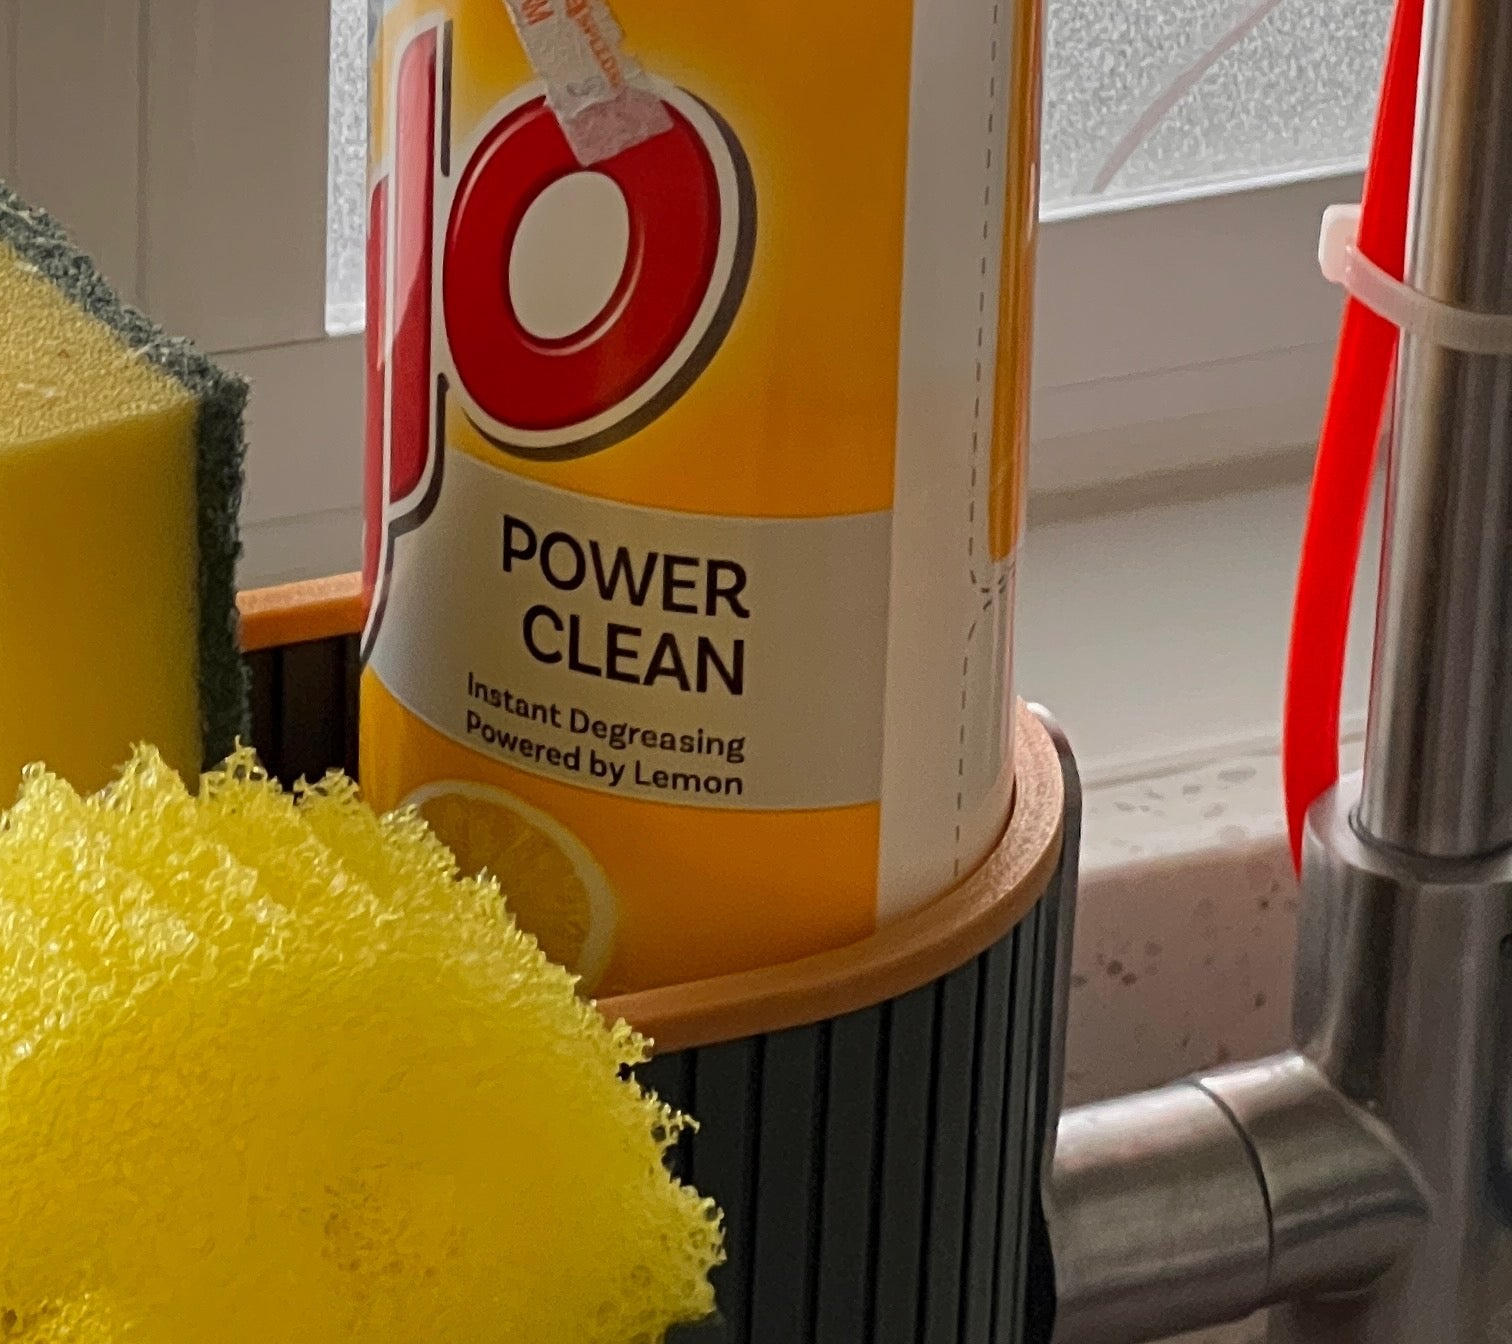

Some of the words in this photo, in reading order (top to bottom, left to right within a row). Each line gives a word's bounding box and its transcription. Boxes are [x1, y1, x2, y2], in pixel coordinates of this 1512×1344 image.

[502, 513, 751, 619] POWER
[522, 603, 745, 696] CLEAN
[466, 709, 581, 772] Powered
[589, 749, 626, 787] by
[634, 759, 744, 796] Lemon
[467, 671, 562, 729] Instant
[569, 707, 746, 764] Degreasing
